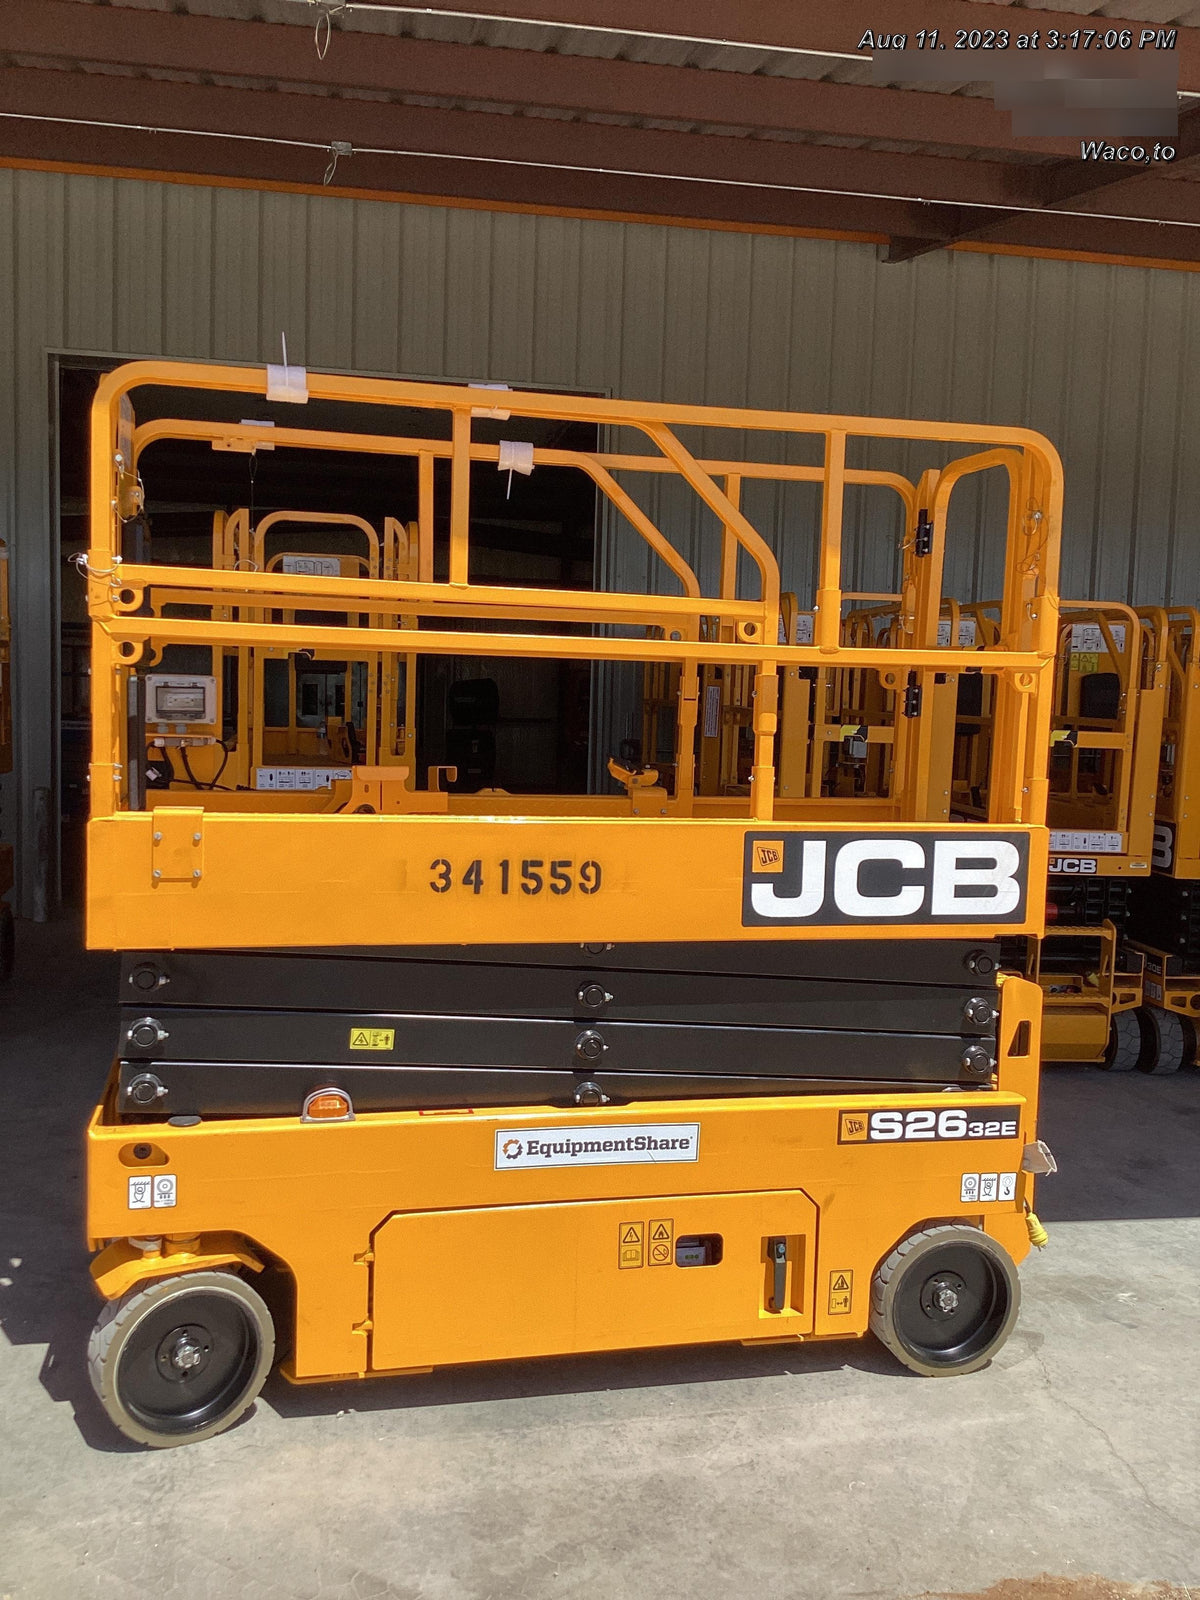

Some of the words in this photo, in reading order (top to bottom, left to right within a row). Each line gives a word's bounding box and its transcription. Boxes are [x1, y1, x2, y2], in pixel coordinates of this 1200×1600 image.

[760, 848, 779, 864] JCB
[1048, 858, 1097, 873] JCB
[429, 859, 602, 895] 341559
[751, 839, 1021, 918] JCB
[870, 1109, 968, 1140] S26
[968, 1121, 1017, 1138] 32E
[526, 1136, 691, 1158] EquipmentShare
